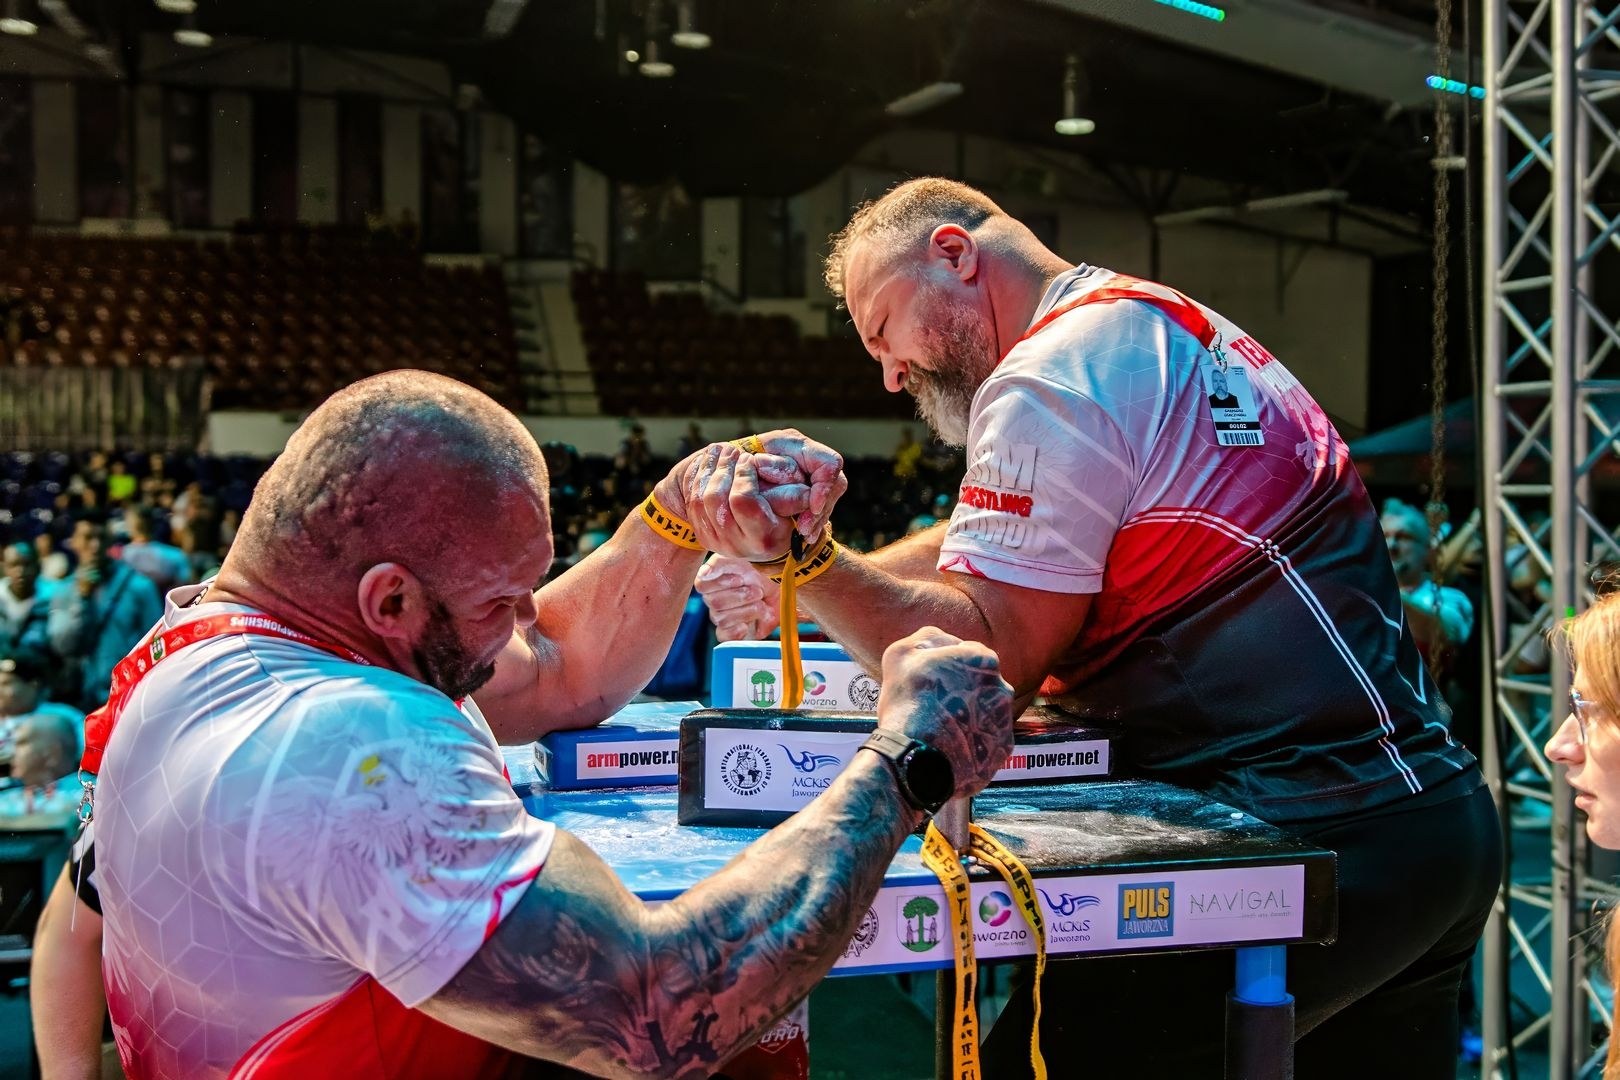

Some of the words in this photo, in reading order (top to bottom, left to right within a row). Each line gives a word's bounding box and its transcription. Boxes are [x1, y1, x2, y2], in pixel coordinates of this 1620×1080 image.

[1229, 336, 1273, 370] TEA
[802, 698, 838, 707] worzno
[587, 750, 679, 769] armpower.n
[720, 743, 754, 773] INTERNATIONAL
[754, 746, 772, 780] FEDERATION
[721, 774, 761, 796] ARMWRESTLING
[792, 788, 823, 799] Jaworz
[1123, 887, 1170, 920] PULS
[973, 929, 1028, 943] worzno
[1123, 919, 1169, 935] JAWORZNA
[1050, 934, 1091, 944] Jaworzno
